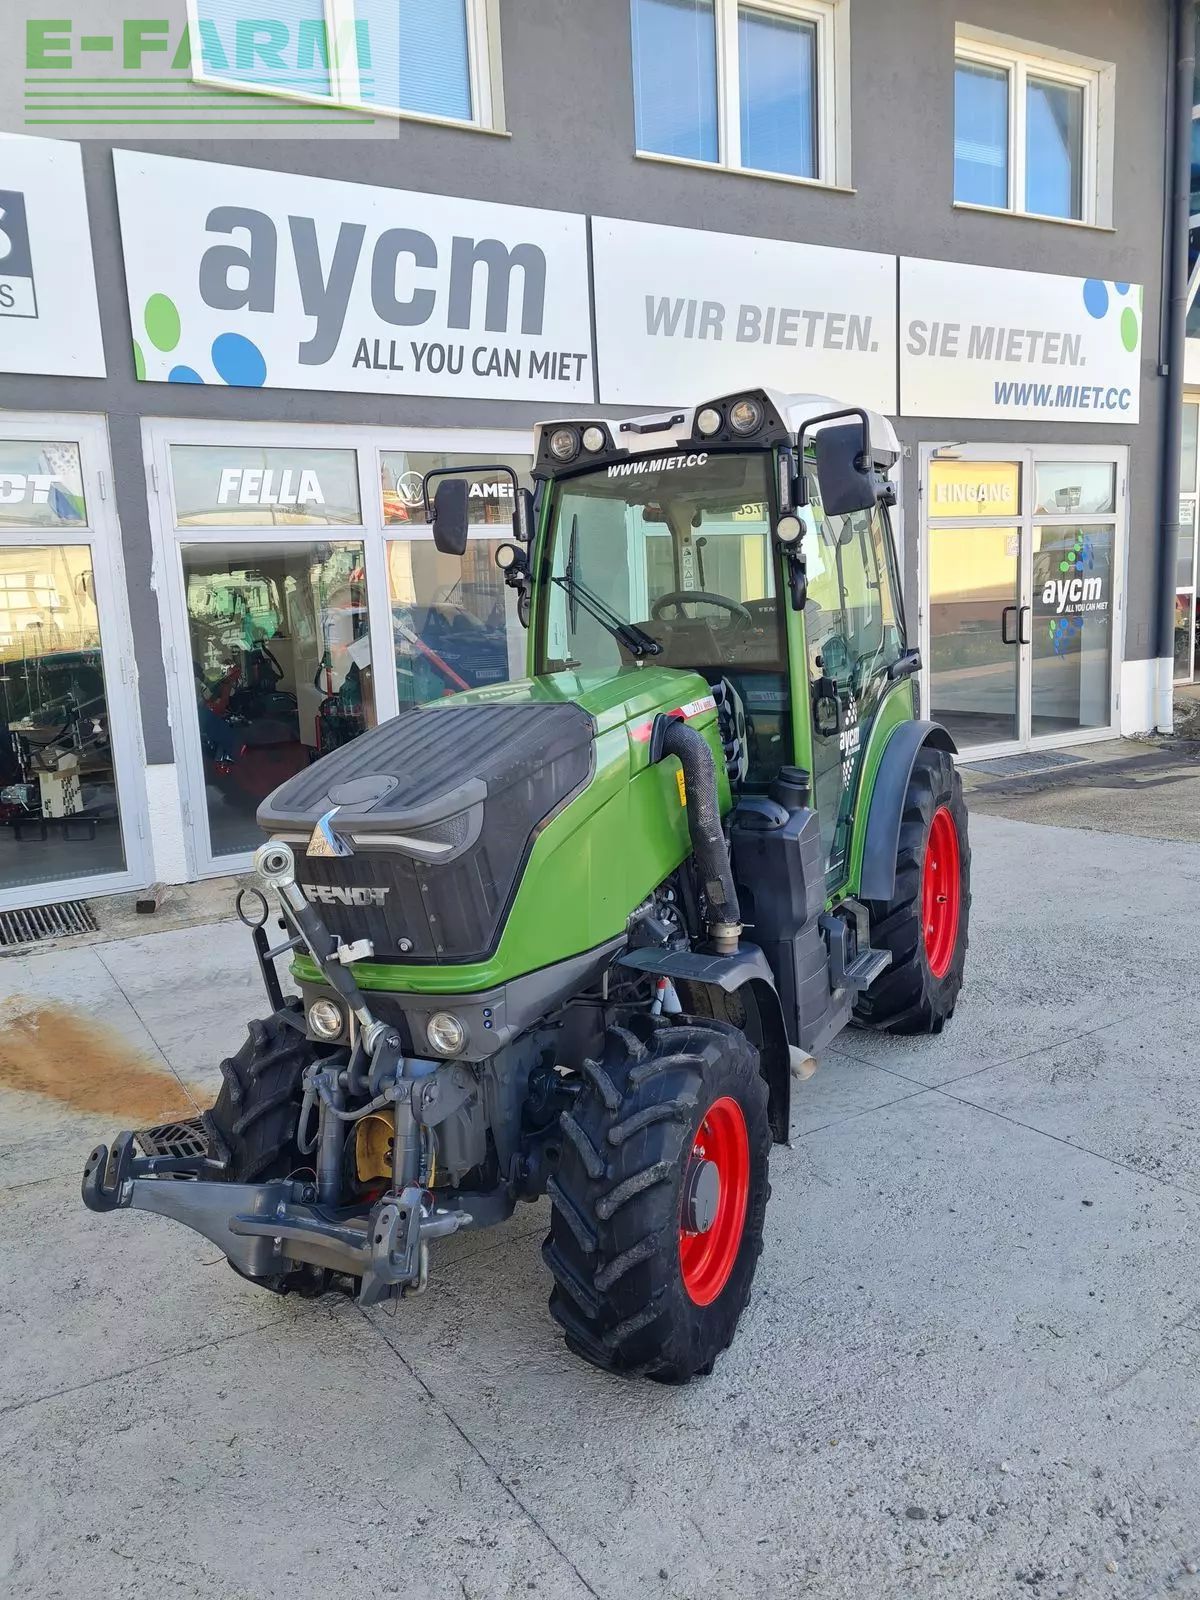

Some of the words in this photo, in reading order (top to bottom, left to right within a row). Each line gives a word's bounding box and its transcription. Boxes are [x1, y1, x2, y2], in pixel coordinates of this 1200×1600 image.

[199, 205, 547, 367] aycm
[645, 295, 726, 341] WIR
[735, 304, 879, 352] BIETEN.
[352, 337, 404, 371] ALL
[410, 341, 464, 375] YOU
[472, 346, 521, 378] CAN
[528, 350, 588, 382] MIET
[906, 319, 961, 358] SIE
[967, 325, 1087, 367] MIETEN.
[994, 381, 1131, 410] WWW.MIET.CC
[607, 452, 708, 478] WWW.MIET.CC
[217, 468, 326, 504] FELLA
[936, 483, 1012, 503] EINGANG
[1042, 576, 1102, 614] aycm
[1065, 604, 1075, 613] ALL
[1075, 603, 1086, 612] YOU
[1085, 602, 1096, 611] CAN
[1096, 601, 1109, 610] MIET
[840, 726, 860, 757] aycm
[301, 884, 390, 906] FENDT
